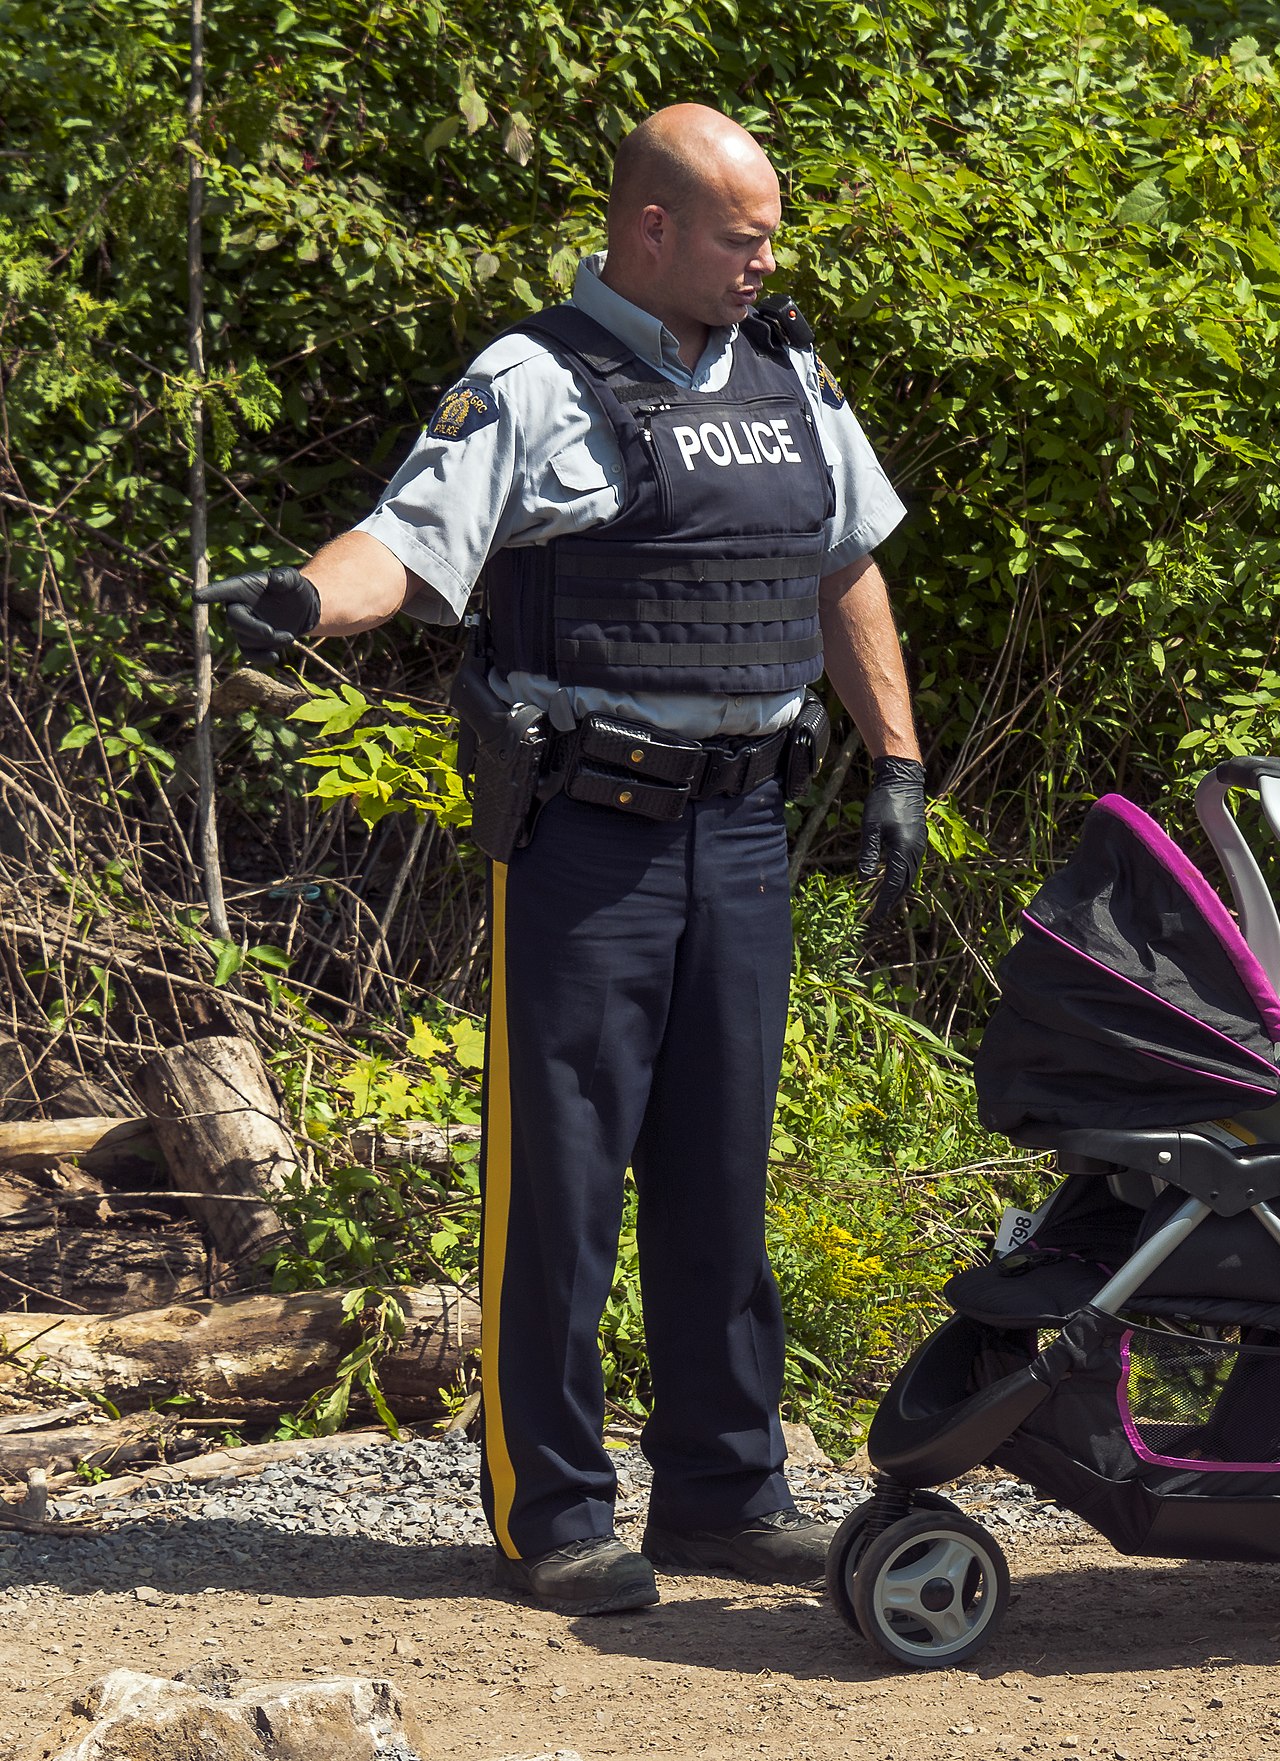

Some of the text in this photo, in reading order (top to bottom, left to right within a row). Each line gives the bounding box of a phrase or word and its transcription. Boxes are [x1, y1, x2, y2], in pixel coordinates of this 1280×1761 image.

[470, 395, 488, 413] GRC
[433, 424, 460, 436] POLICE
[672, 419, 802, 471] POLICE
[1008, 1217, 1032, 1247] 798
